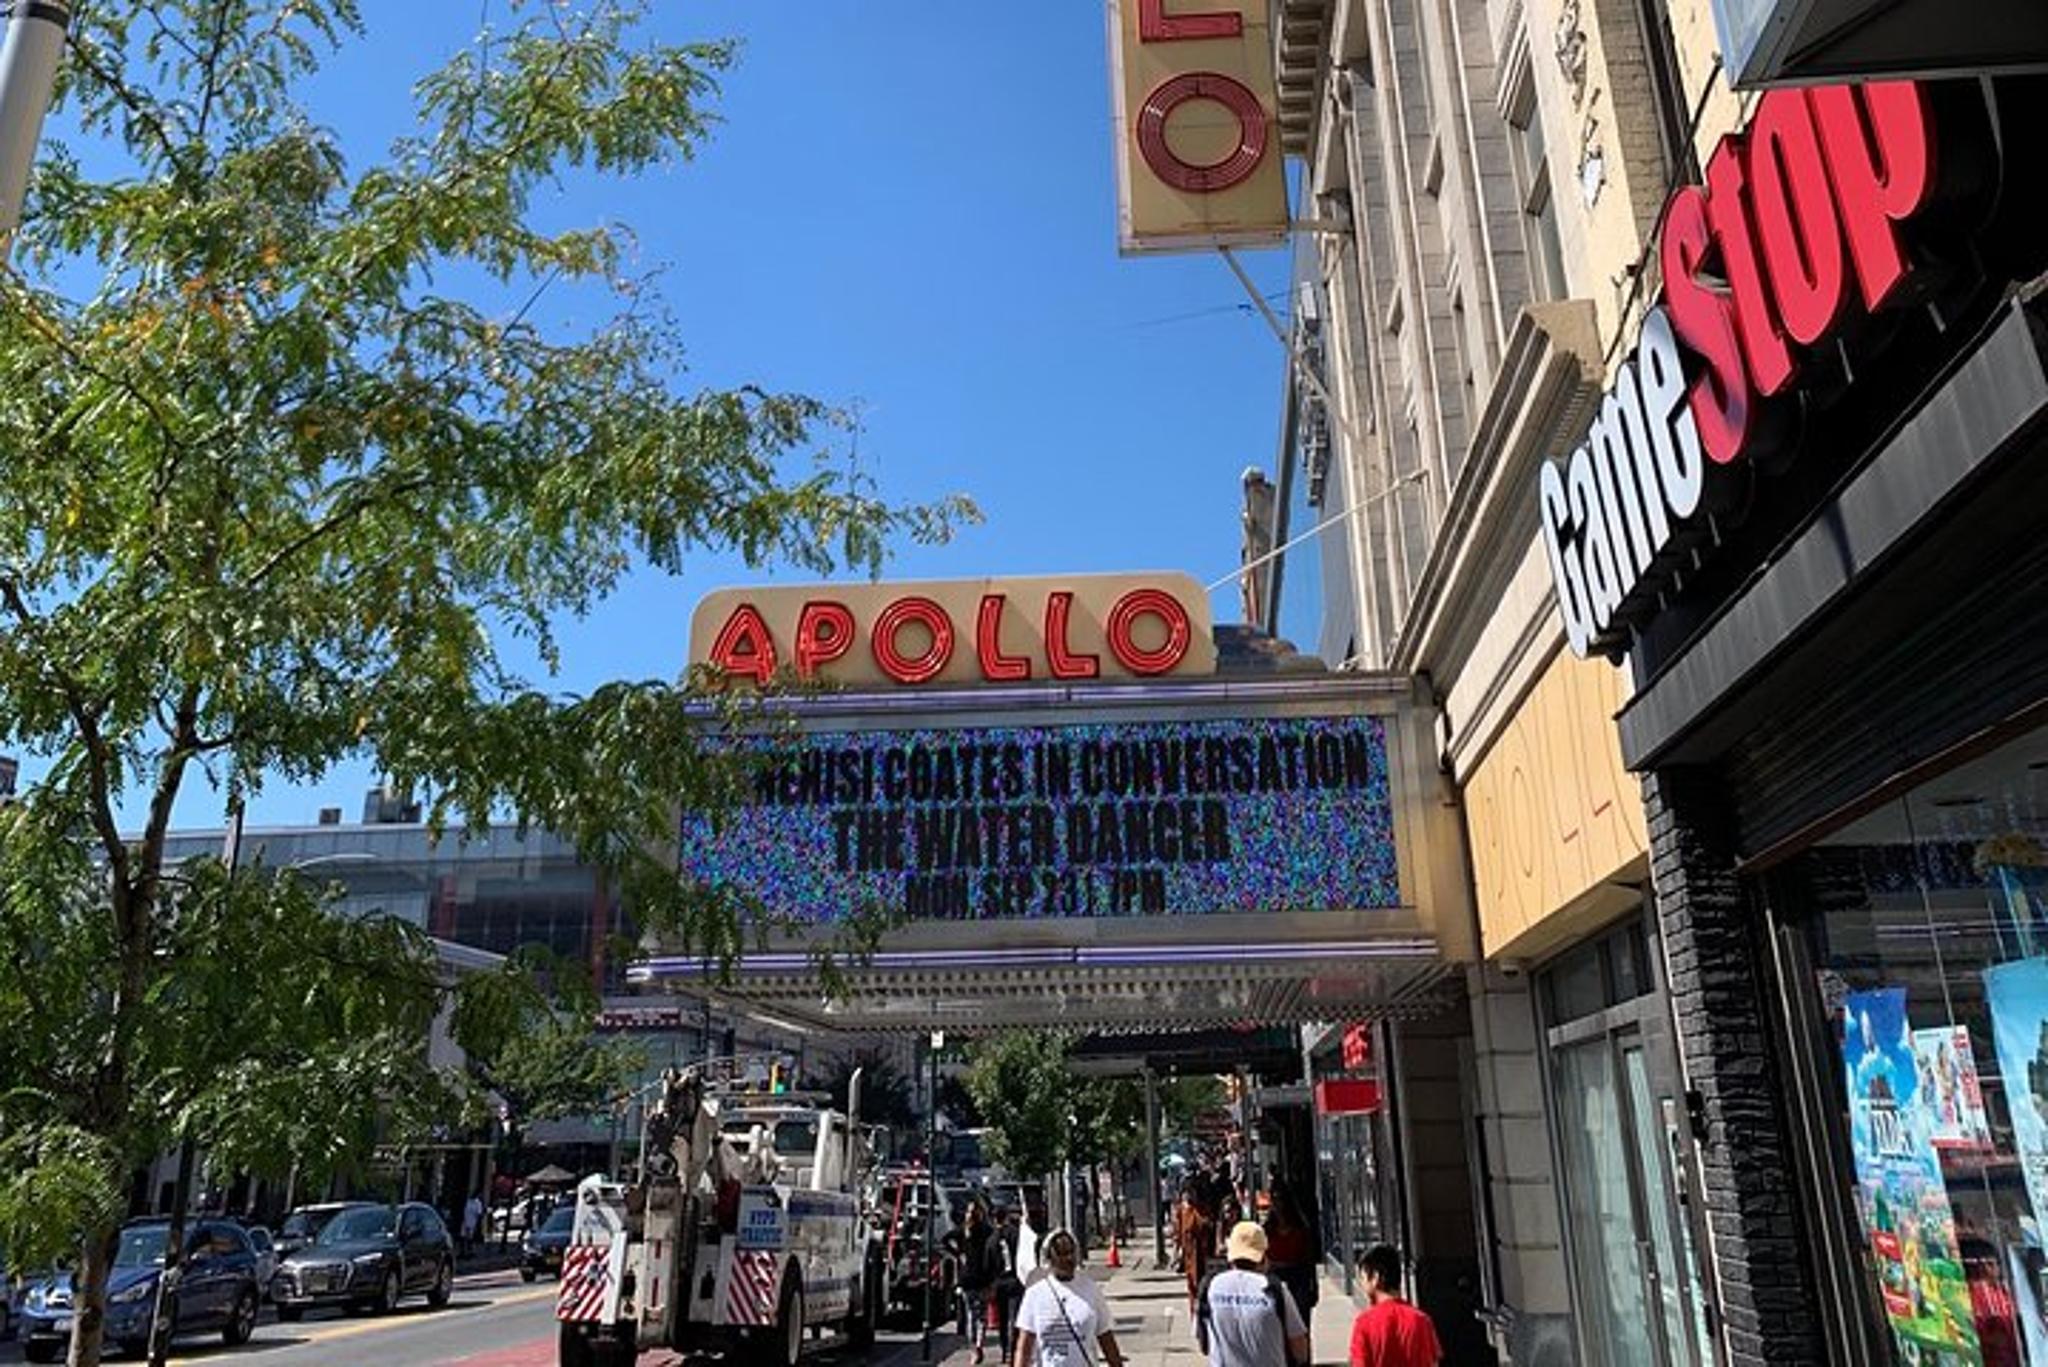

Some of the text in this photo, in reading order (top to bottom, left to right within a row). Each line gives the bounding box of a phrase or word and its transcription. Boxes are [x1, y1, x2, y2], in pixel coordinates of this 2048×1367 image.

[1540, 78, 1933, 660] GameStop
[709, 588, 1191, 686] APOLLO
[884, 744, 1024, 803] COATES
[1033, 741, 1071, 798] IN
[1080, 730, 1369, 797] CONVERSATION
[831, 800, 1232, 872] THE WATER DANCER
